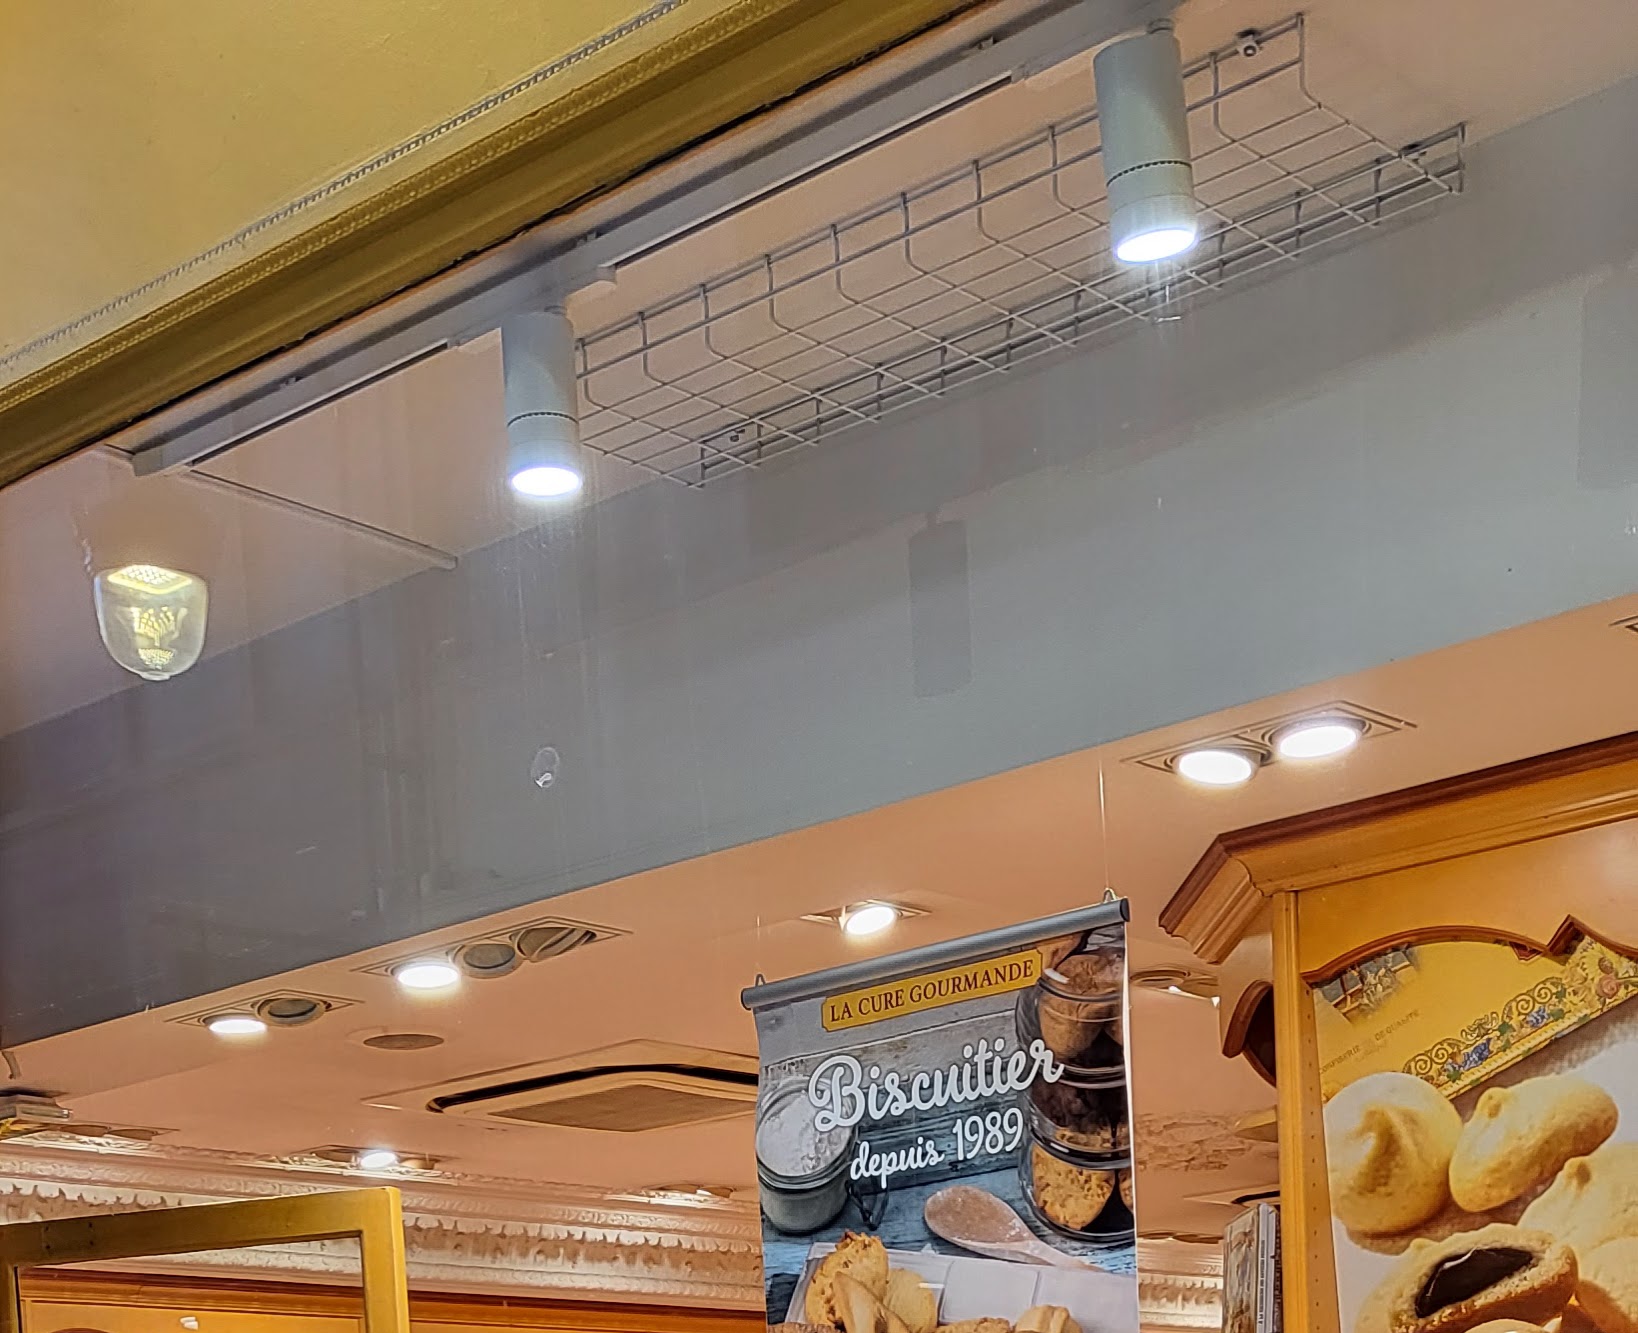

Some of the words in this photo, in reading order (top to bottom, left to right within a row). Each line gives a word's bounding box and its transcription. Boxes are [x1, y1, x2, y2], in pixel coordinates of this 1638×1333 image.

[830, 1004, 853, 1023] LA
[858, 989, 904, 1016] CURE
[909, 960, 1033, 1004] GOURMANDE
[809, 1038, 1065, 1132] Biscuitier
[850, 1137, 945, 1189] depuis
[952, 1108, 1024, 1161] 1989
